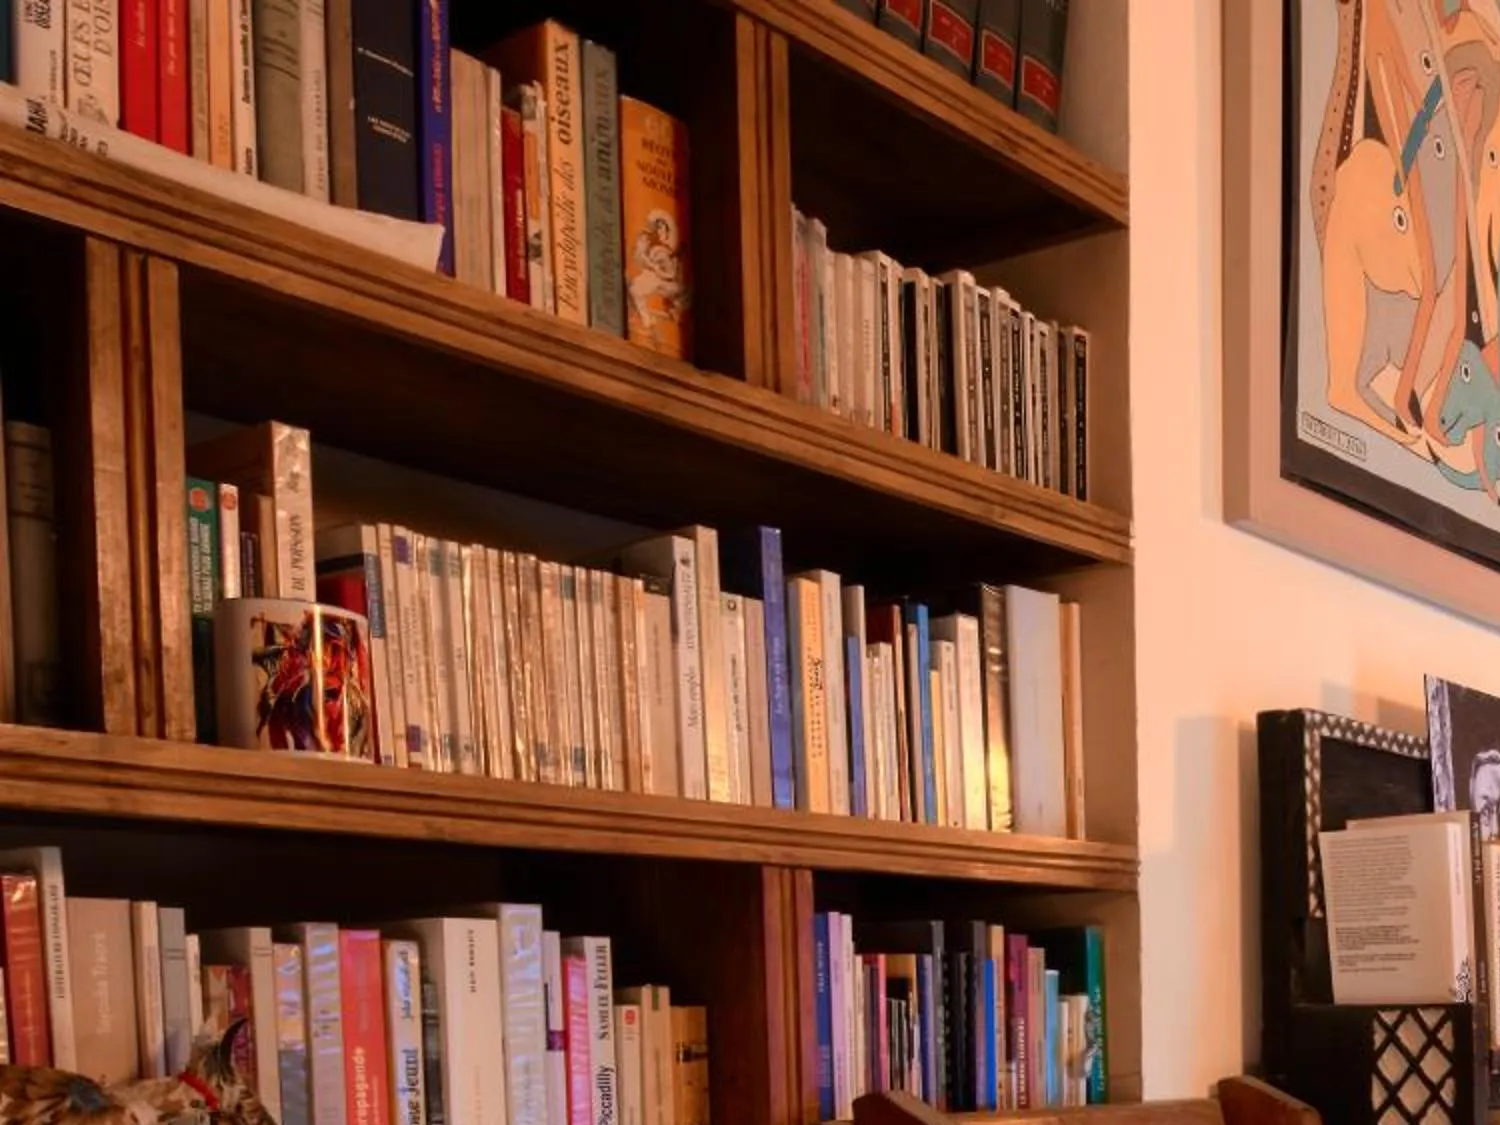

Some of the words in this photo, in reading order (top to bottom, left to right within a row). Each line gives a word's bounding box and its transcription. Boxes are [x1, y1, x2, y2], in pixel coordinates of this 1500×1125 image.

[550, 38, 573, 146] oiseaux
[591, 68, 613, 183] animaux
[553, 159, 576, 190] des
[554, 191, 583, 312] Encyclopédie
